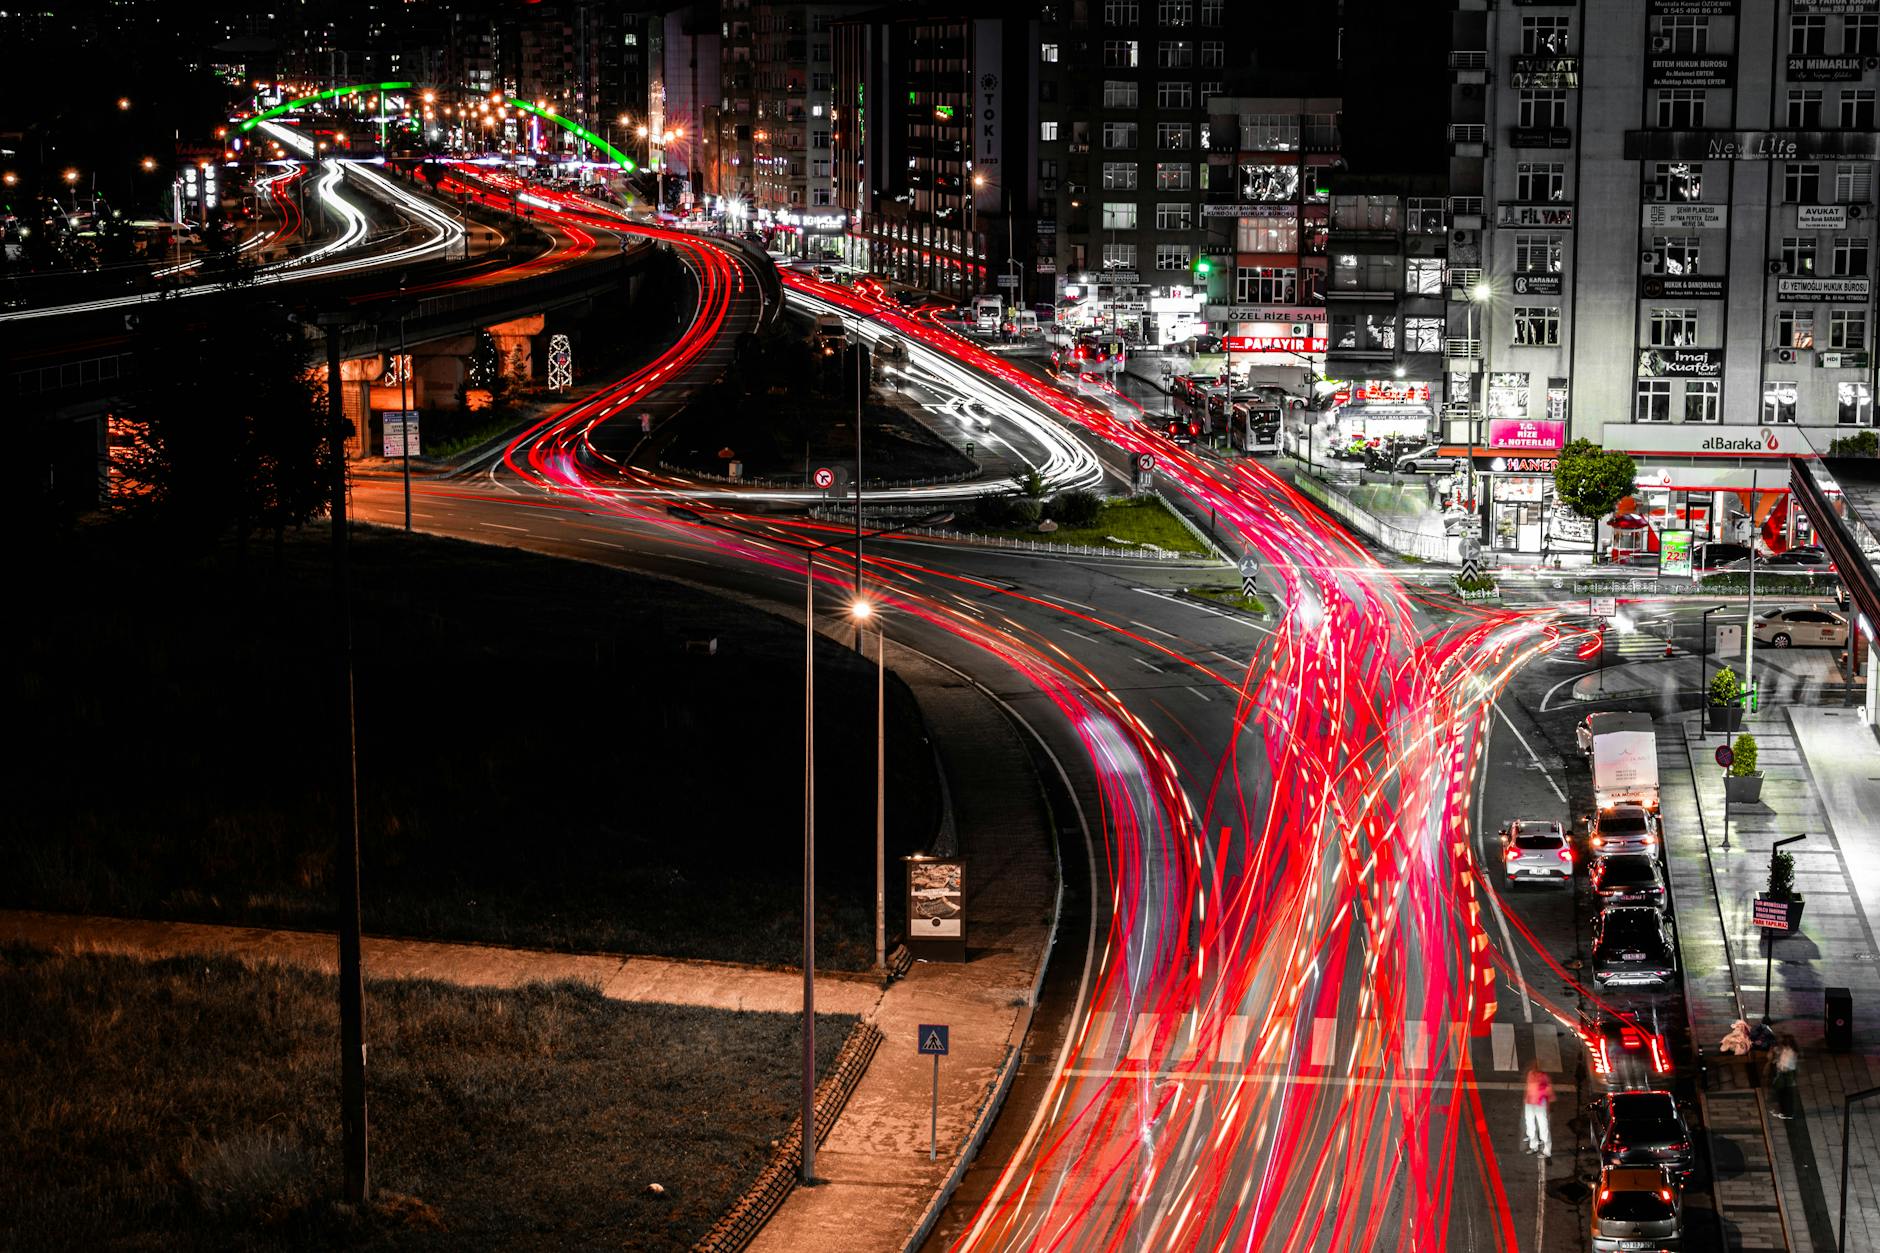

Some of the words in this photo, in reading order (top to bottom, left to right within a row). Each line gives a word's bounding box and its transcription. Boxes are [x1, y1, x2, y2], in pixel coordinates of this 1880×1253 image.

[1676, 60, 1699, 68] HUKUK
[1788, 59, 1804, 70] 2N
[1708, 138, 1747, 153] New
[1758, 134, 1798, 154] Life
[1521, 208, 1540, 224] FİL
[1824, 281, 1843, 291] HUKUK
[1844, 281, 1867, 292] BÜROSU
[1229, 310, 1261, 320] ÖZEL
[1264, 312, 1291, 320] RİZE
[1244, 337, 1304, 350] PANAYIR
[1675, 350, 1708, 364] İmaj
[1665, 361, 1718, 373] Kuaför
[1517, 430, 1538, 438] RİZE
[1508, 438, 1556, 447] NOTERLİĞİ
[1702, 437, 1761, 450] alBaraka
